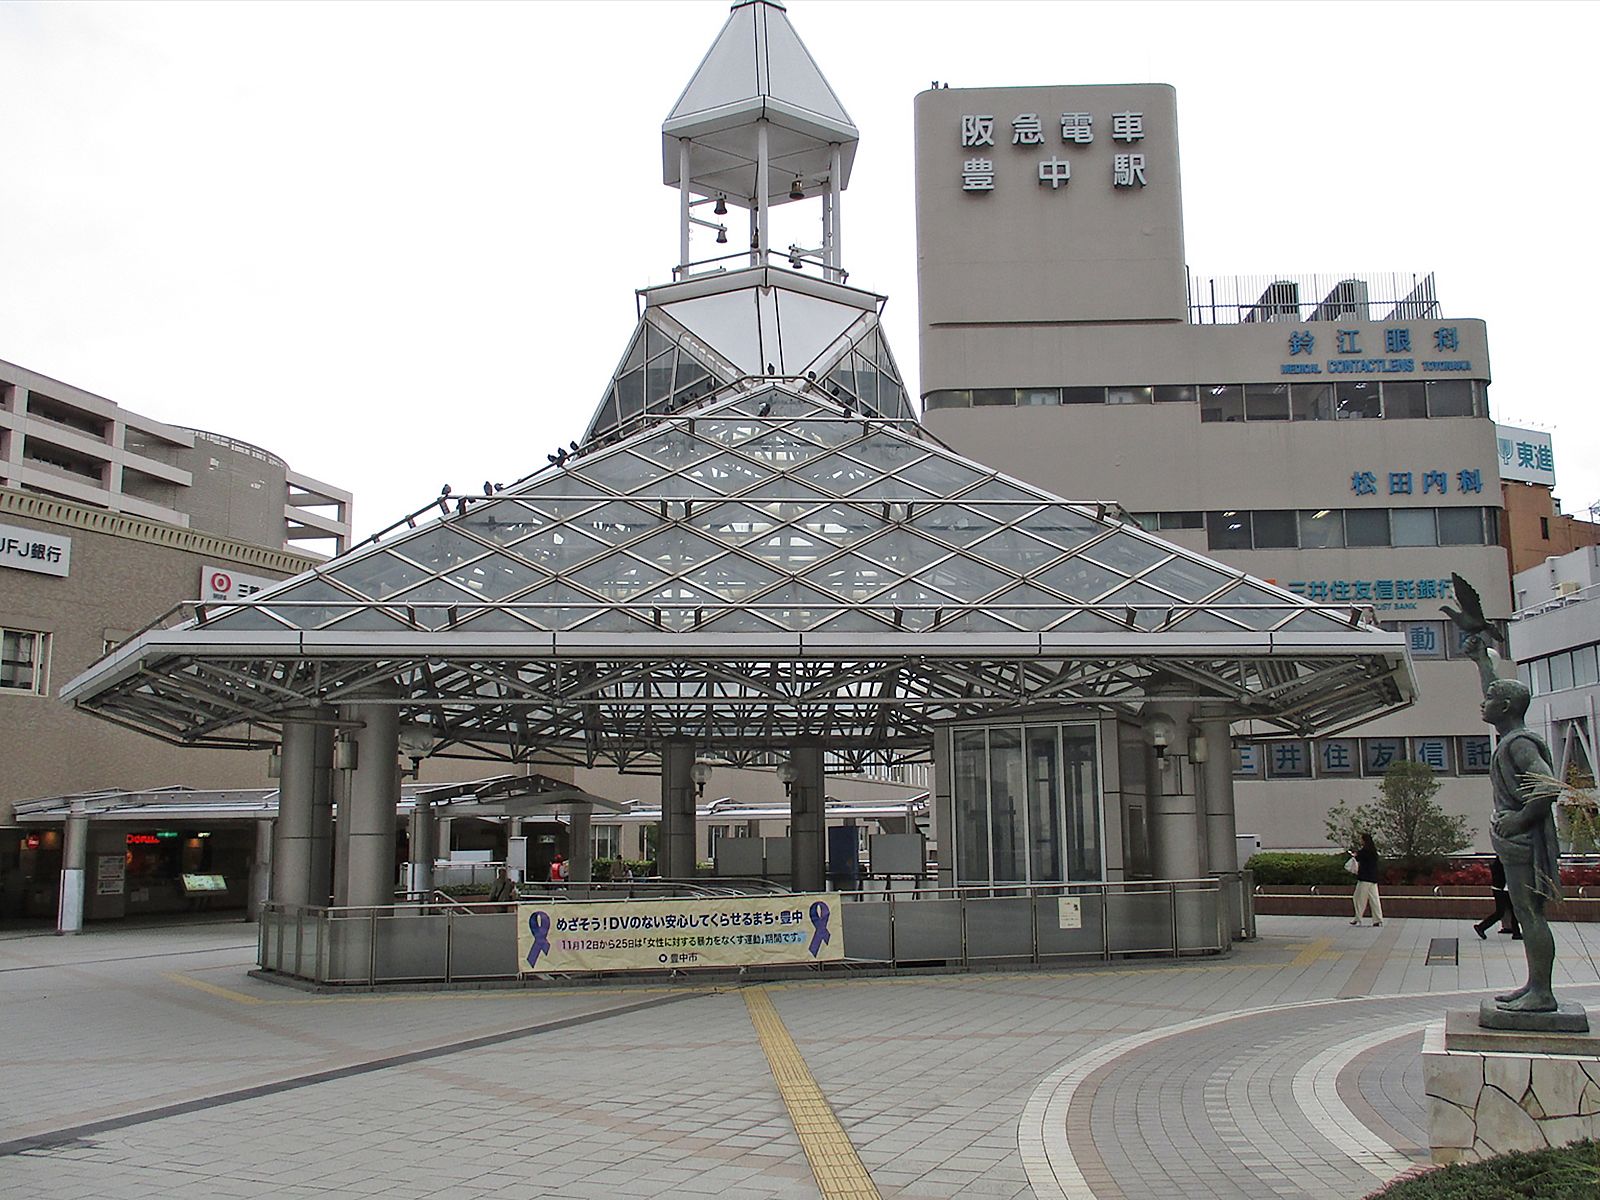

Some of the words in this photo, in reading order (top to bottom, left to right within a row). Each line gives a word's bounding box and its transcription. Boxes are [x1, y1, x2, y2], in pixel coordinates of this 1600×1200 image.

[961, 110, 1145, 148] 阪急電車
[961, 153, 1147, 191] 豊中駅
[1288, 327, 1459, 356] 鈴江眼科
[1516, 441, 1552, 471] 東進
[1351, 467, 1484, 496] 松田内科
[1288, 579, 1454, 601] 三井住友信託銀行
[670, 953, 698, 964] 豊中市
